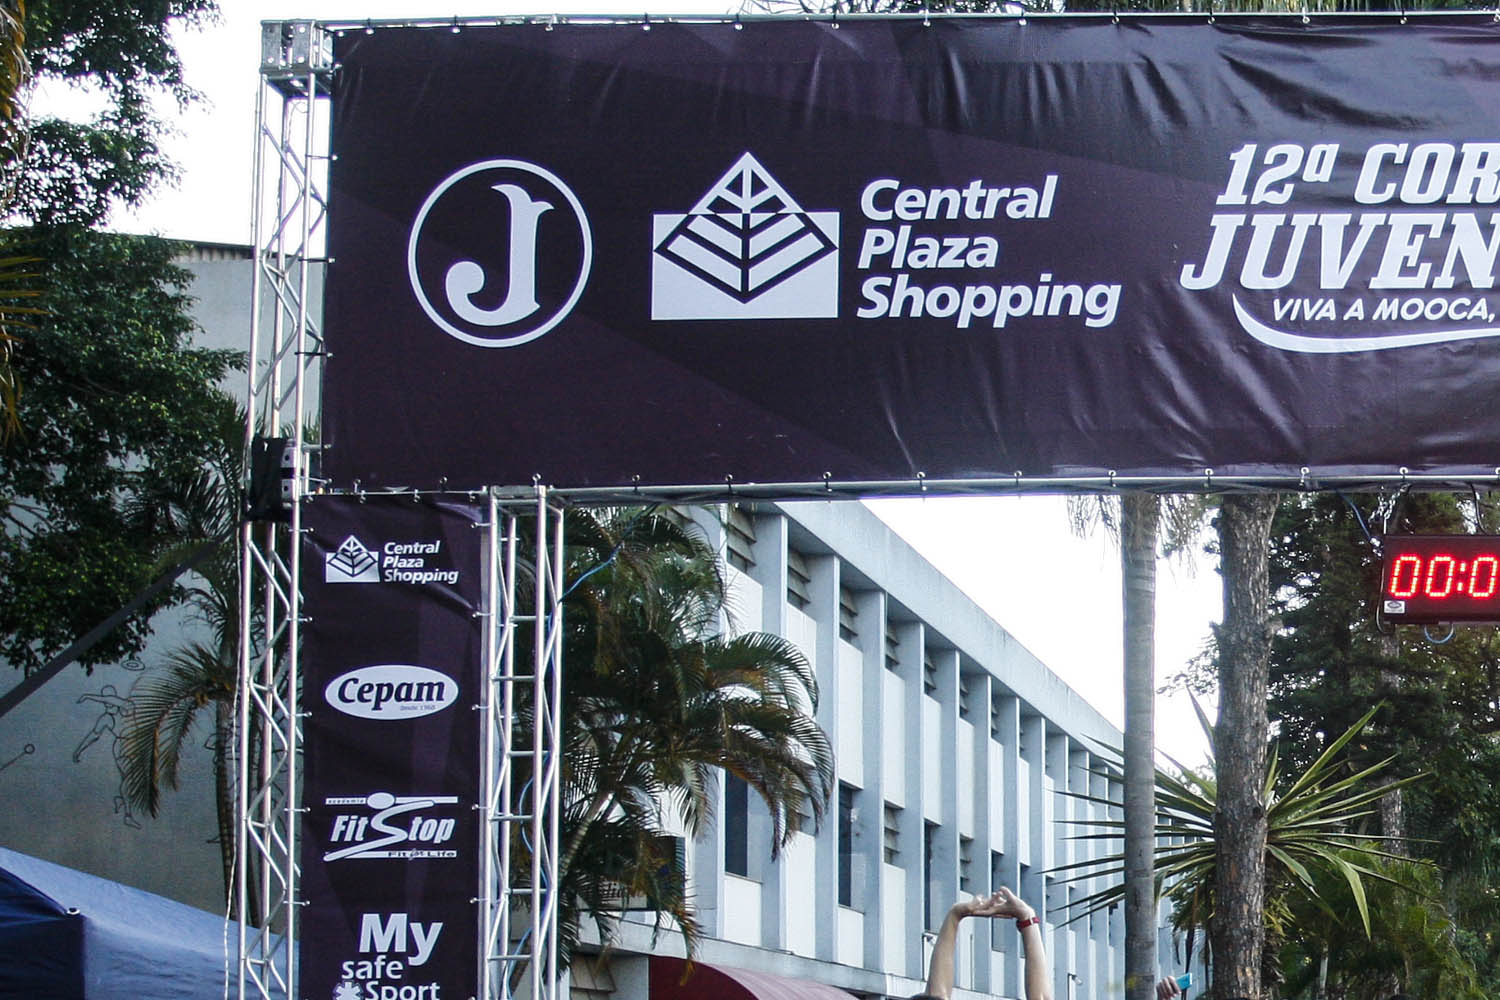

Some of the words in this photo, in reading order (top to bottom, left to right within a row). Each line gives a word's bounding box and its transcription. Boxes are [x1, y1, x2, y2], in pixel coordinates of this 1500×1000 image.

[859, 175, 1057, 222] Central
[857, 226, 998, 269] Plaza
[856, 275, 1121, 328] Shopping
[1272, 297, 1337, 321] VIVA
[1344, 298, 1365, 321] A
[1373, 297, 1496, 323] MOOCA,
[383, 540, 440, 555] Central
[383, 556, 424, 569] Plaza
[384, 569, 459, 585] Shopping
[337, 677, 445, 711] Cepam
[359, 913, 443, 966] My
[342, 954, 403, 980] safe
